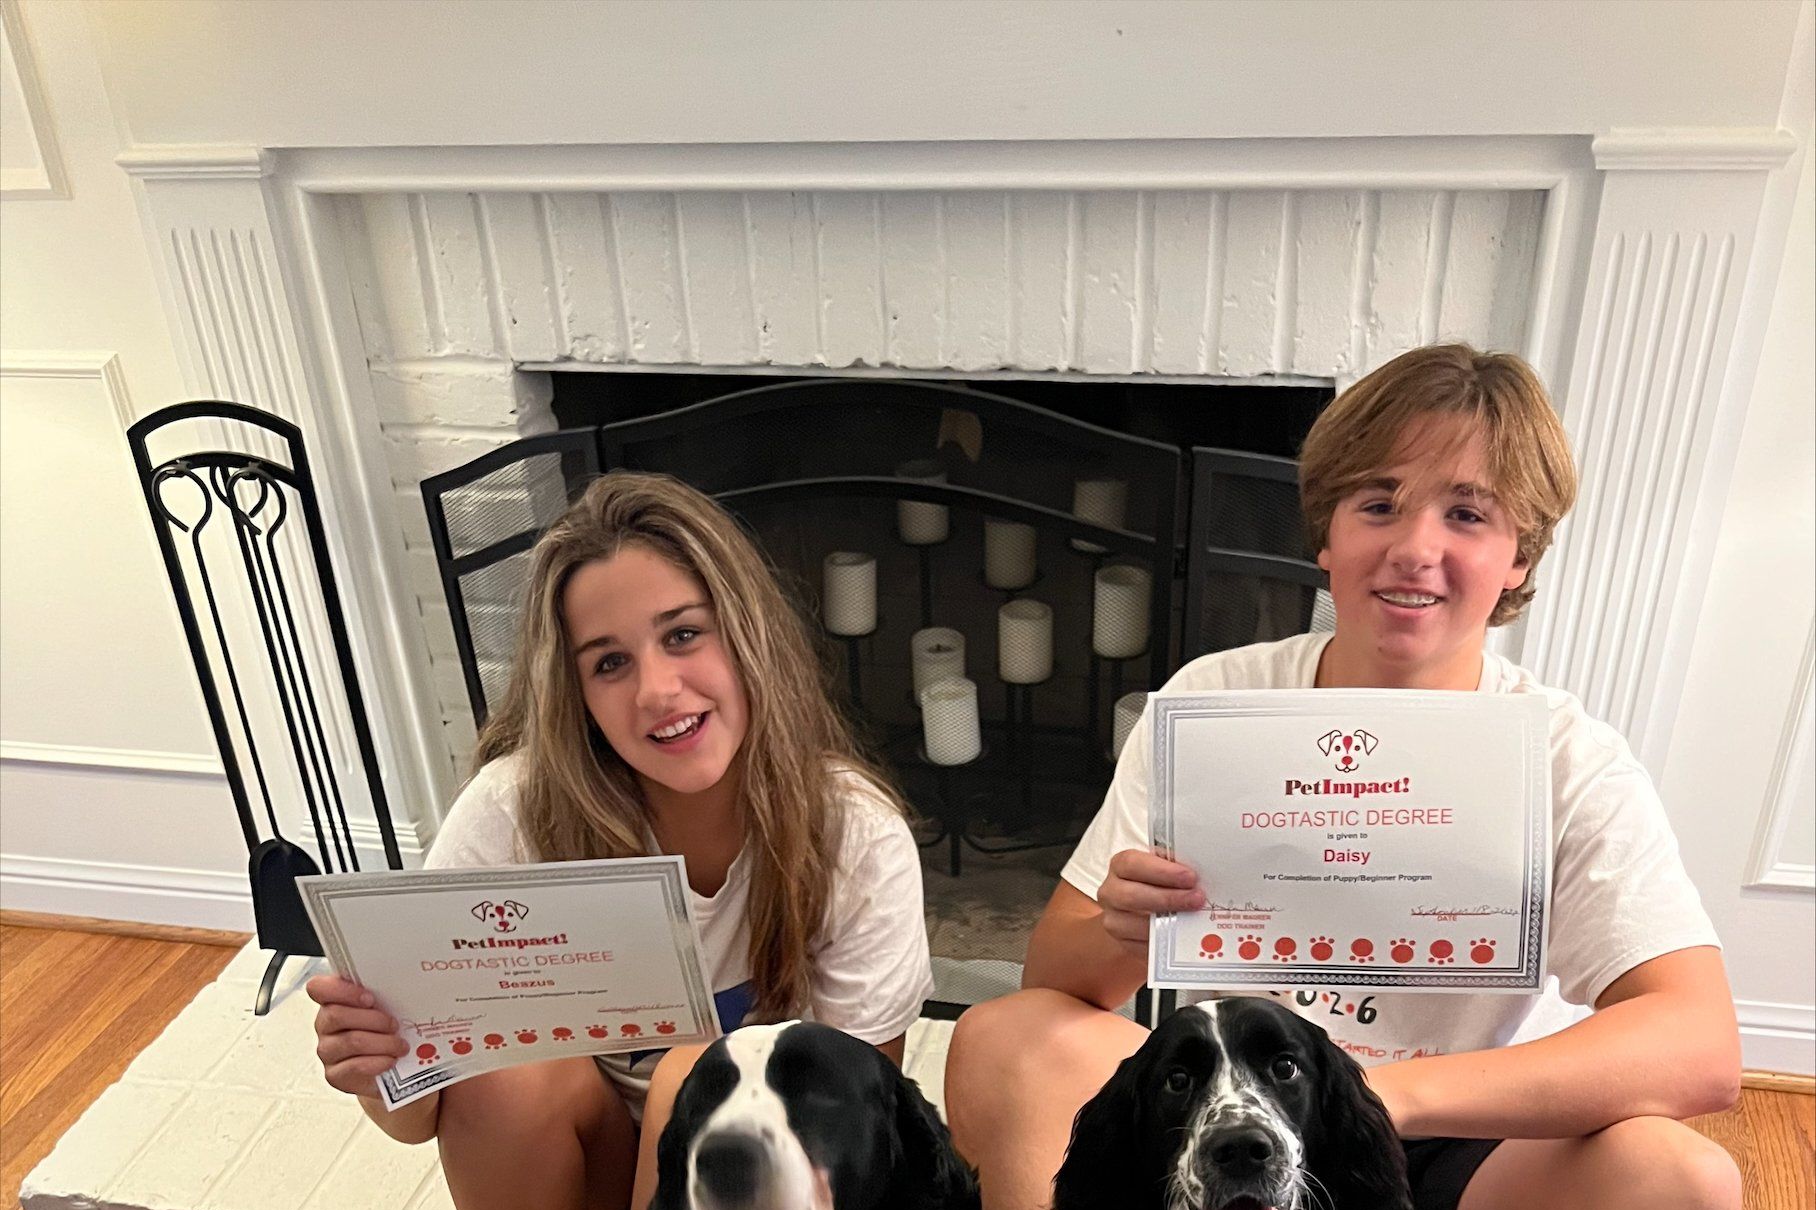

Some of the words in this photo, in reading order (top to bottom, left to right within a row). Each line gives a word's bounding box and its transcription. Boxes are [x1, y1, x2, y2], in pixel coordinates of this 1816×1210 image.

[1285, 777, 1410, 798] PetImpact!
[1241, 810, 1360, 829] DOGTASTIC
[1366, 808, 1453, 826] DEGREE
[1327, 832, 1334, 840] is
[1336, 832, 1358, 841] given
[1359, 832, 1368, 840] to
[1323, 849, 1371, 865] Daisy
[1278, 874, 1322, 882] Completion
[1323, 874, 1331, 882] of
[1398, 874, 1433, 882] Program
[451, 933, 568, 950] PetImpact!
[421, 955, 530, 972] DOGTASTIC
[535, 950, 615, 967] DEGREE
[1331, 1039, 1387, 1058] TARTED
[1393, 1050, 1406, 1060] IT
